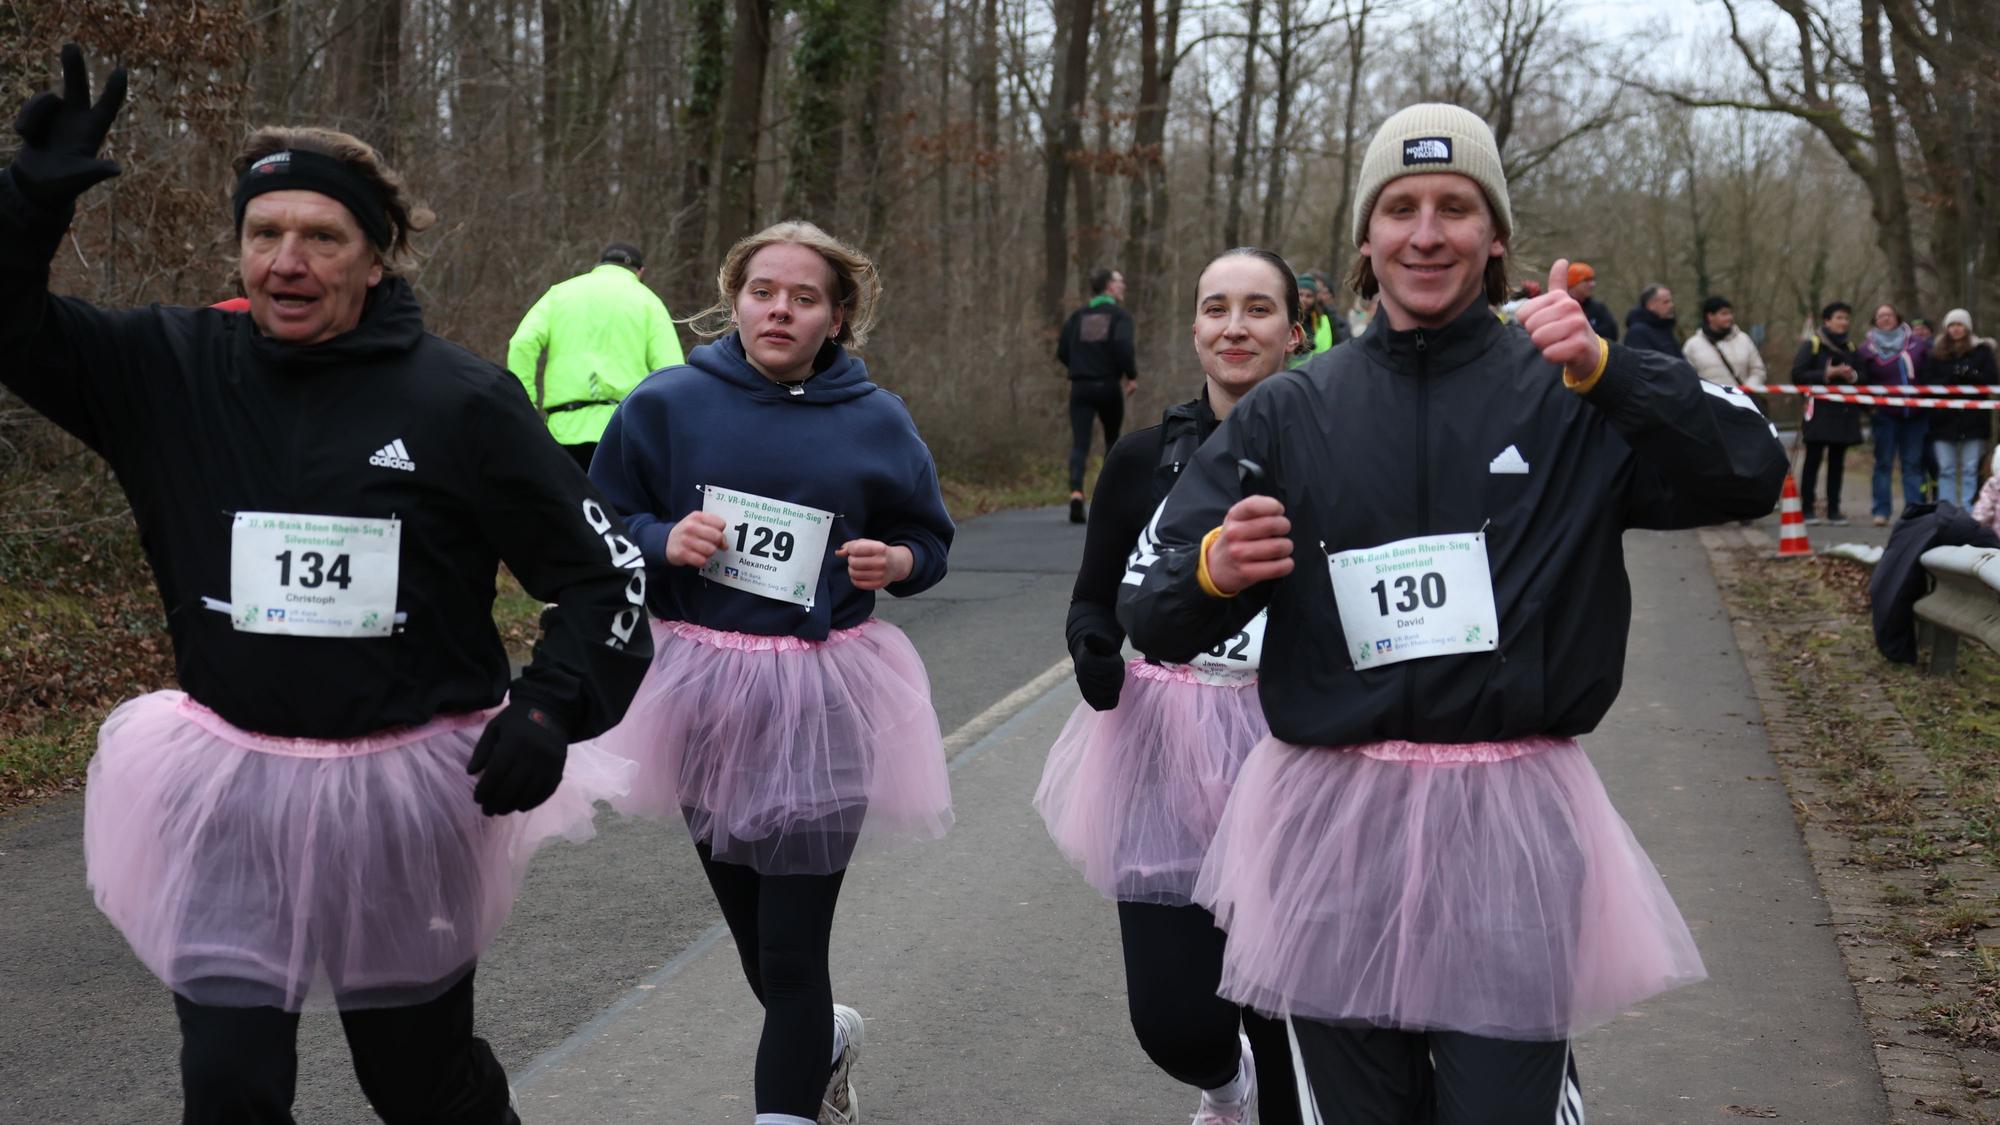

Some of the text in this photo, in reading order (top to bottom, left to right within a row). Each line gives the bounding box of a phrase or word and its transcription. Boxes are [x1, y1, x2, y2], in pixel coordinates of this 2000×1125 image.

[1406, 146, 1433, 154] NORTH
[369, 455, 416, 472] adidas
[715, 493, 822, 525] 37. VR-Bank Bonn Rhein-Sieg
[743, 510, 792, 528] Silvesterlauf
[262, 520, 302, 532] VR-Bank
[304, 522, 331, 533] Bonn
[331, 523, 384, 537] Rhein-Sieg
[283, 534, 345, 547] Silvesterlauf
[734, 522, 795, 562] 129
[1340, 541, 1470, 568] 37. VR-Bank Bonn Rhein-Sieg
[275, 550, 352, 590] 134
[738, 557, 778, 573] Alexandra
[1375, 557, 1433, 575] Silvesterlauf
[285, 593, 336, 605] Christoph
[1370, 572, 1447, 617] 130
[1397, 615, 1425, 629] David
